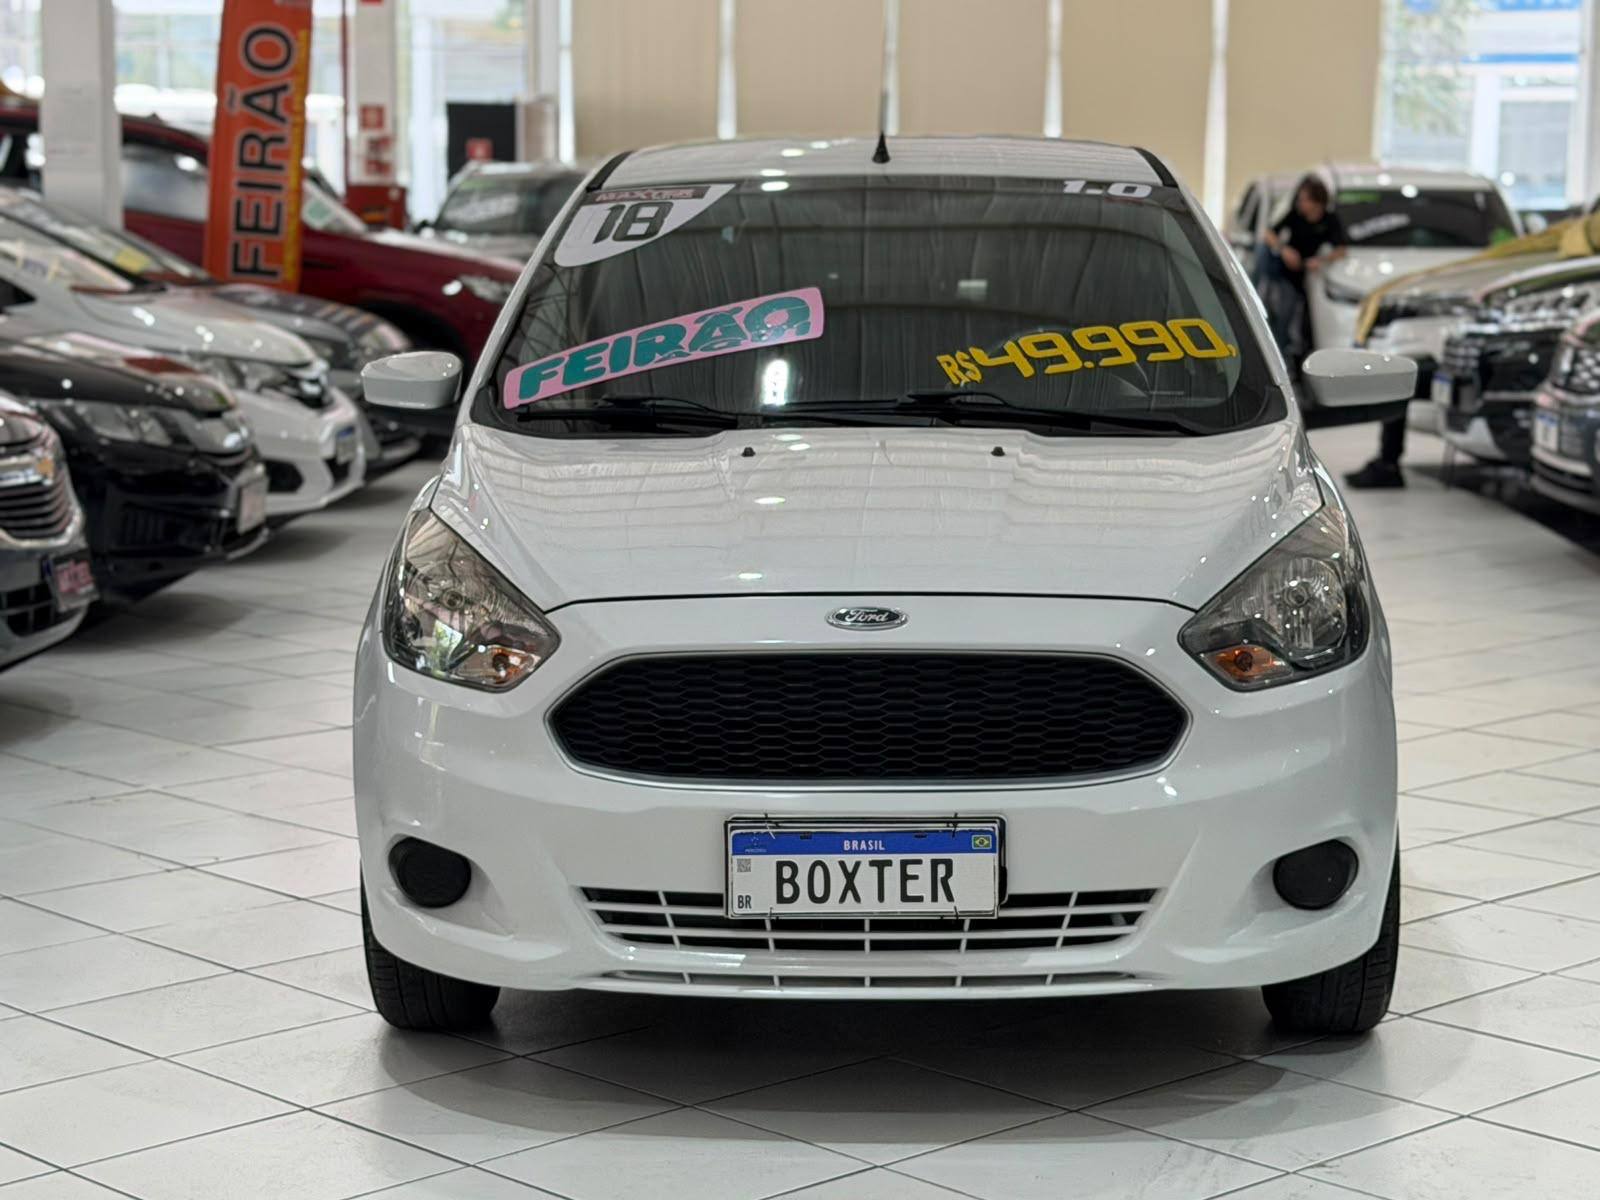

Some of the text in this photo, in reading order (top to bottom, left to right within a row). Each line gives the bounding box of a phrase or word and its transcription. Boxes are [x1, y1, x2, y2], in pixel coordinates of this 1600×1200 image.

[229, 26, 293, 278] FEIRÃO
[1063, 180, 1153, 198] 1.0
[593, 201, 674, 244] 18
[518, 296, 812, 401] FEIRÃO
[844, 608, 890, 622] Ford
[843, 839, 885, 851] BRASIL
[775, 858, 955, 905] BOXTER
[737, 894, 752, 910] BR
